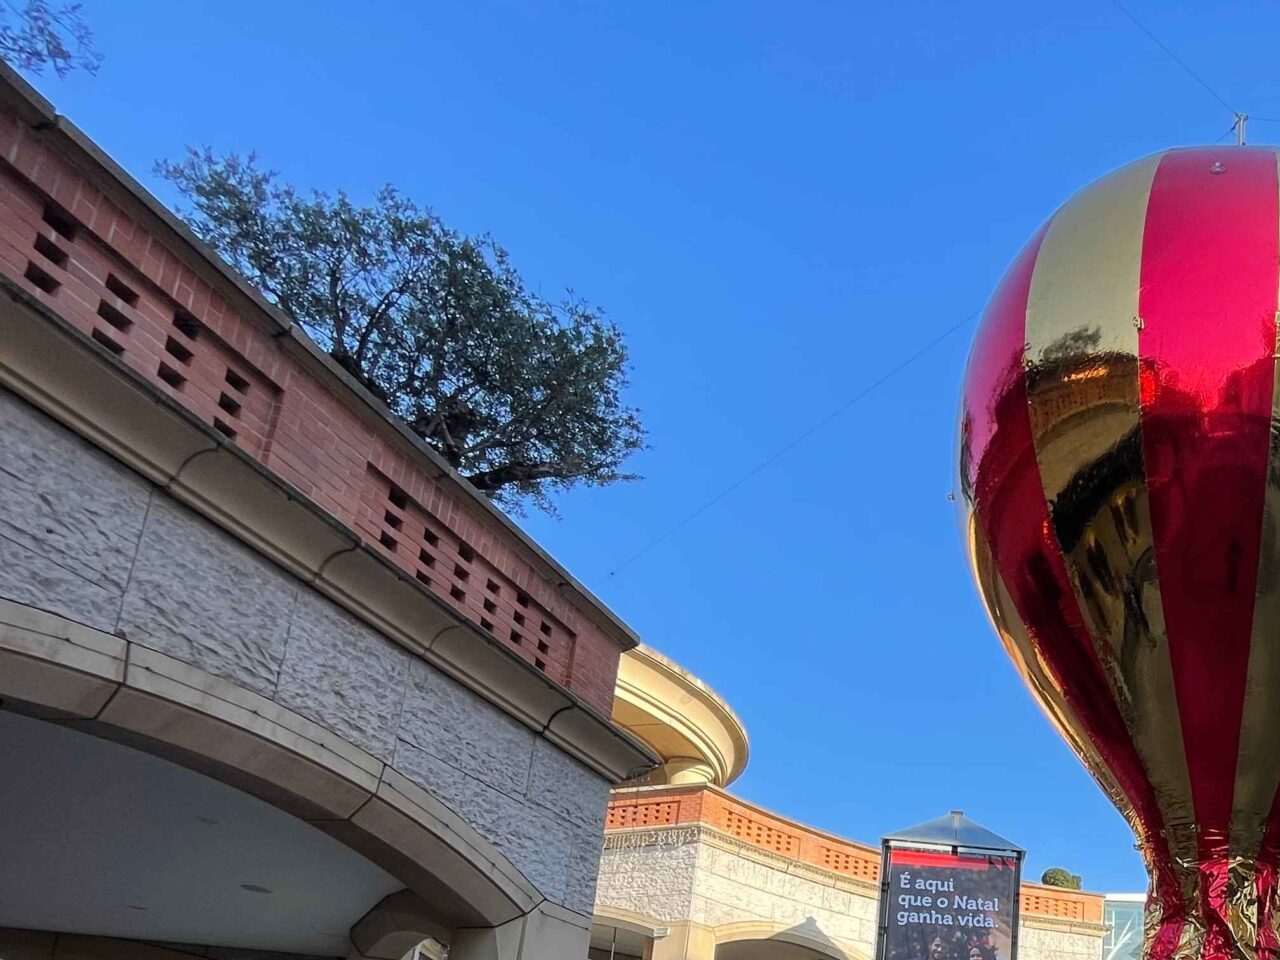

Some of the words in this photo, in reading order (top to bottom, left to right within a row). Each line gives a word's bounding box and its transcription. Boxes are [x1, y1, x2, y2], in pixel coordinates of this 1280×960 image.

[900, 871, 911, 889] É
[915, 878, 954, 894] aqui
[898, 894, 932, 908] que
[937, 897, 948, 908] o
[953, 895, 999, 911] Natal
[897, 910, 953, 926] ganha
[958, 913, 999, 928] vida.
